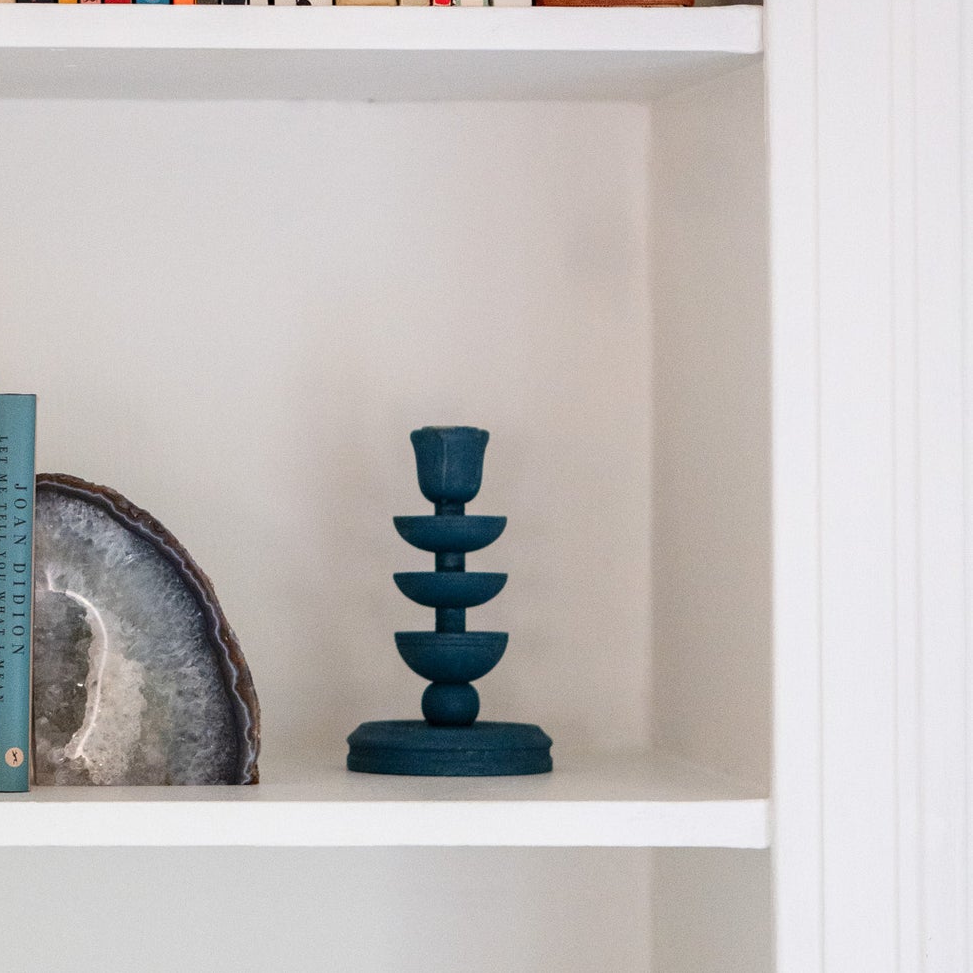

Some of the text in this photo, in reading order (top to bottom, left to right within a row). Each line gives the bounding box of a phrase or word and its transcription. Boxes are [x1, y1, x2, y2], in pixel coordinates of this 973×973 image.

[0, 436, 8, 465] LET
[12, 483, 28, 657] JOAN DIDION
